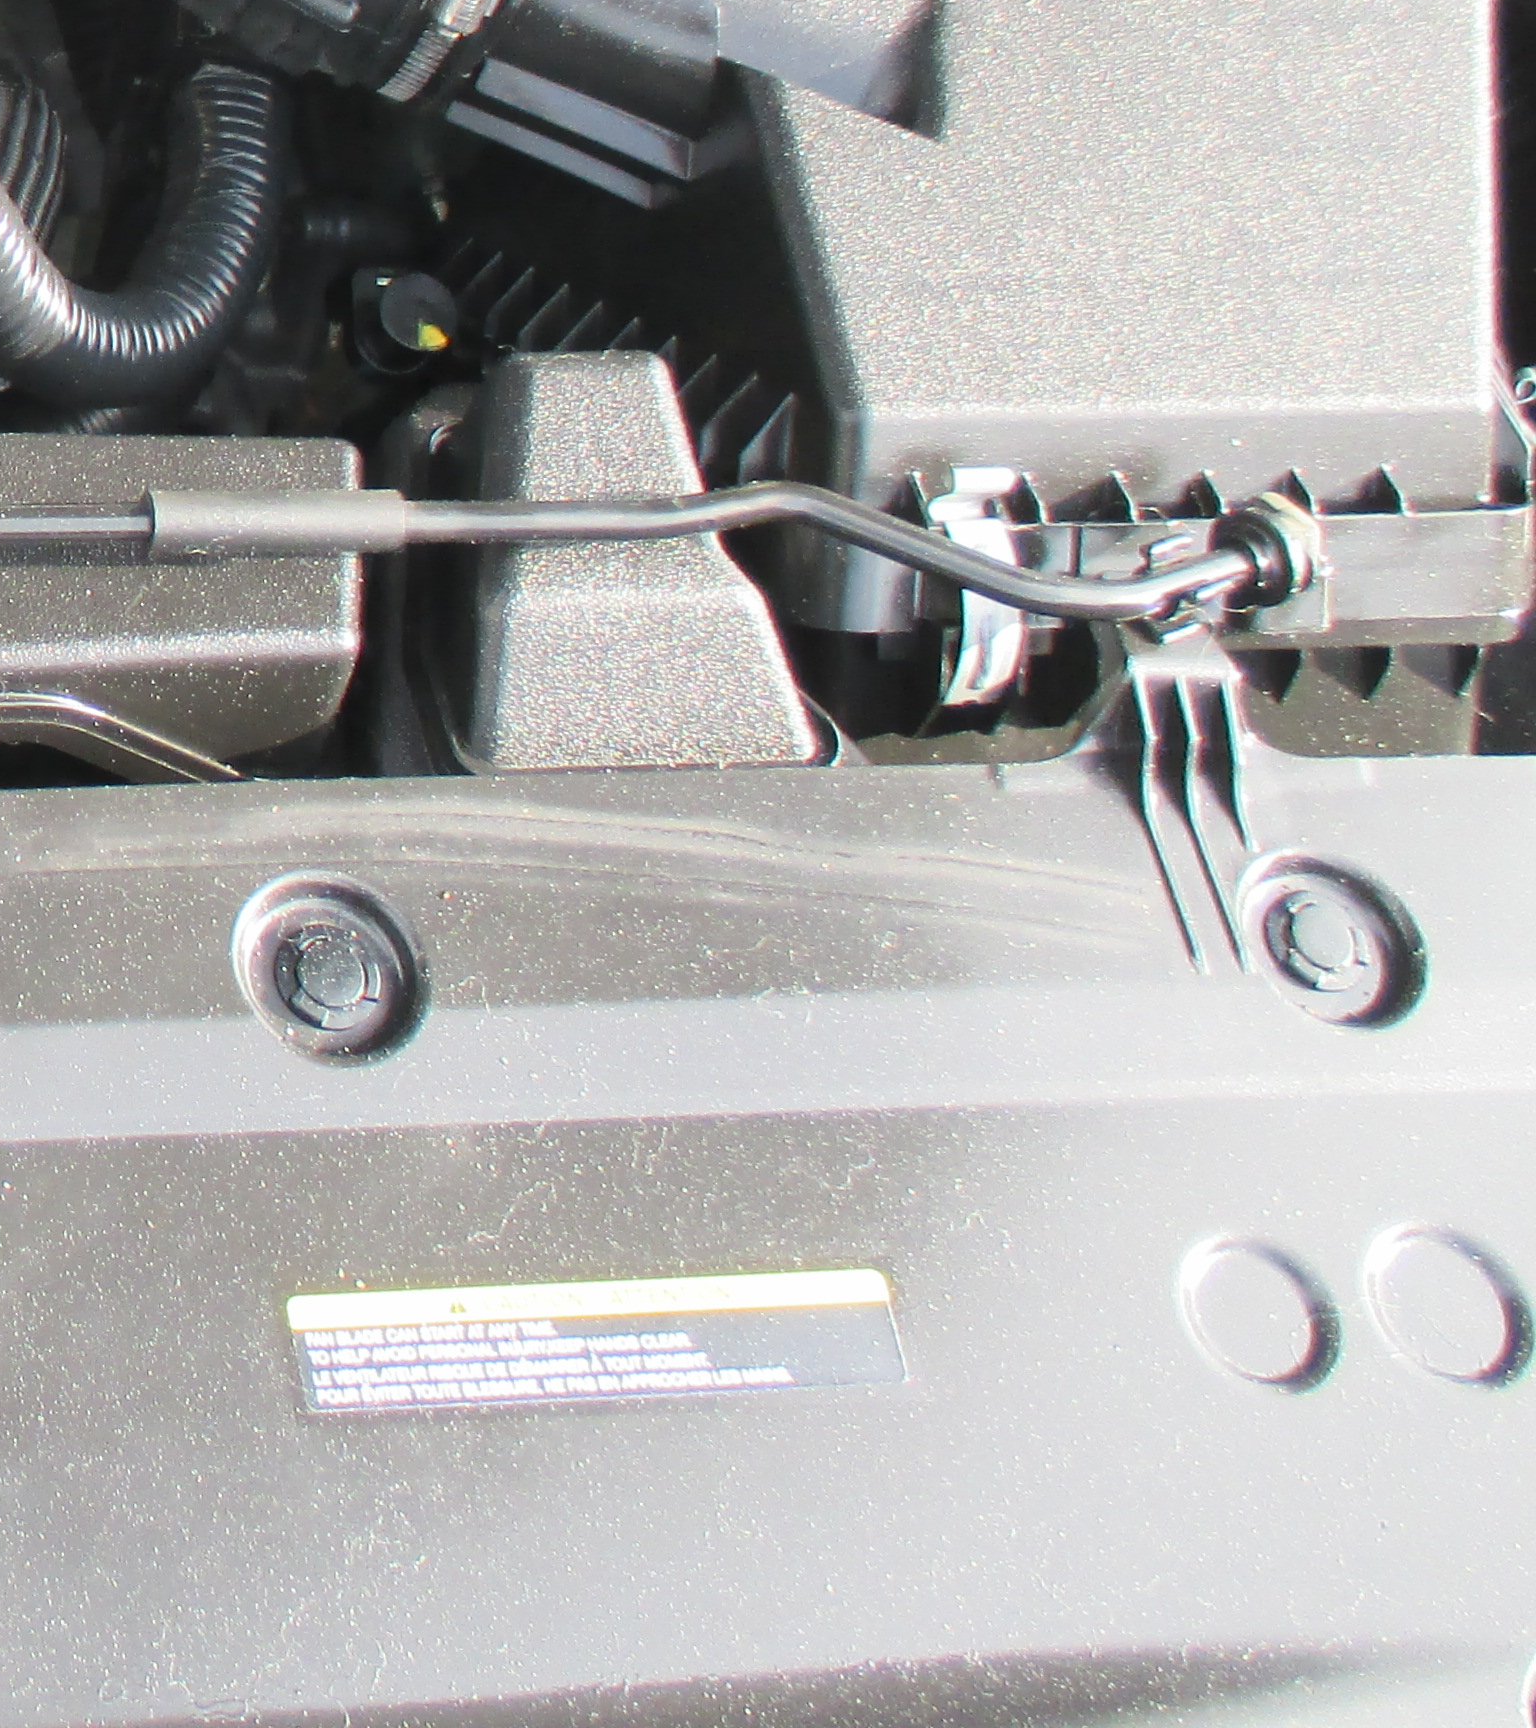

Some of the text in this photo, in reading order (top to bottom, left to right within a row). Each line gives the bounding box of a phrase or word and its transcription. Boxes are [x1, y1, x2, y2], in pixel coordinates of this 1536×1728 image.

[483, 1284, 732, 1313] CAUTION ATTENTION
[336, 1328, 385, 1347] BLADE
[386, 1326, 418, 1345] CAN
[420, 1324, 465, 1344] START
[466, 1322, 485, 1341] AT
[487, 1321, 519, 1340] ANY
[308, 1349, 331, 1366] TO
[332, 1347, 371, 1365] HELP
[373, 1345, 417, 1363] AVOID
[419, 1341, 498, 1361] PERSONAL
[587, 1334, 641, 1353] HANDS
[312, 1369, 332, 1387] LE
[485, 1361, 507, 1379] DE
[602, 1354, 643, 1372] TOUT
[317, 1387, 361, 1405] POUR
[414, 1381, 461, 1400] TOUTE
